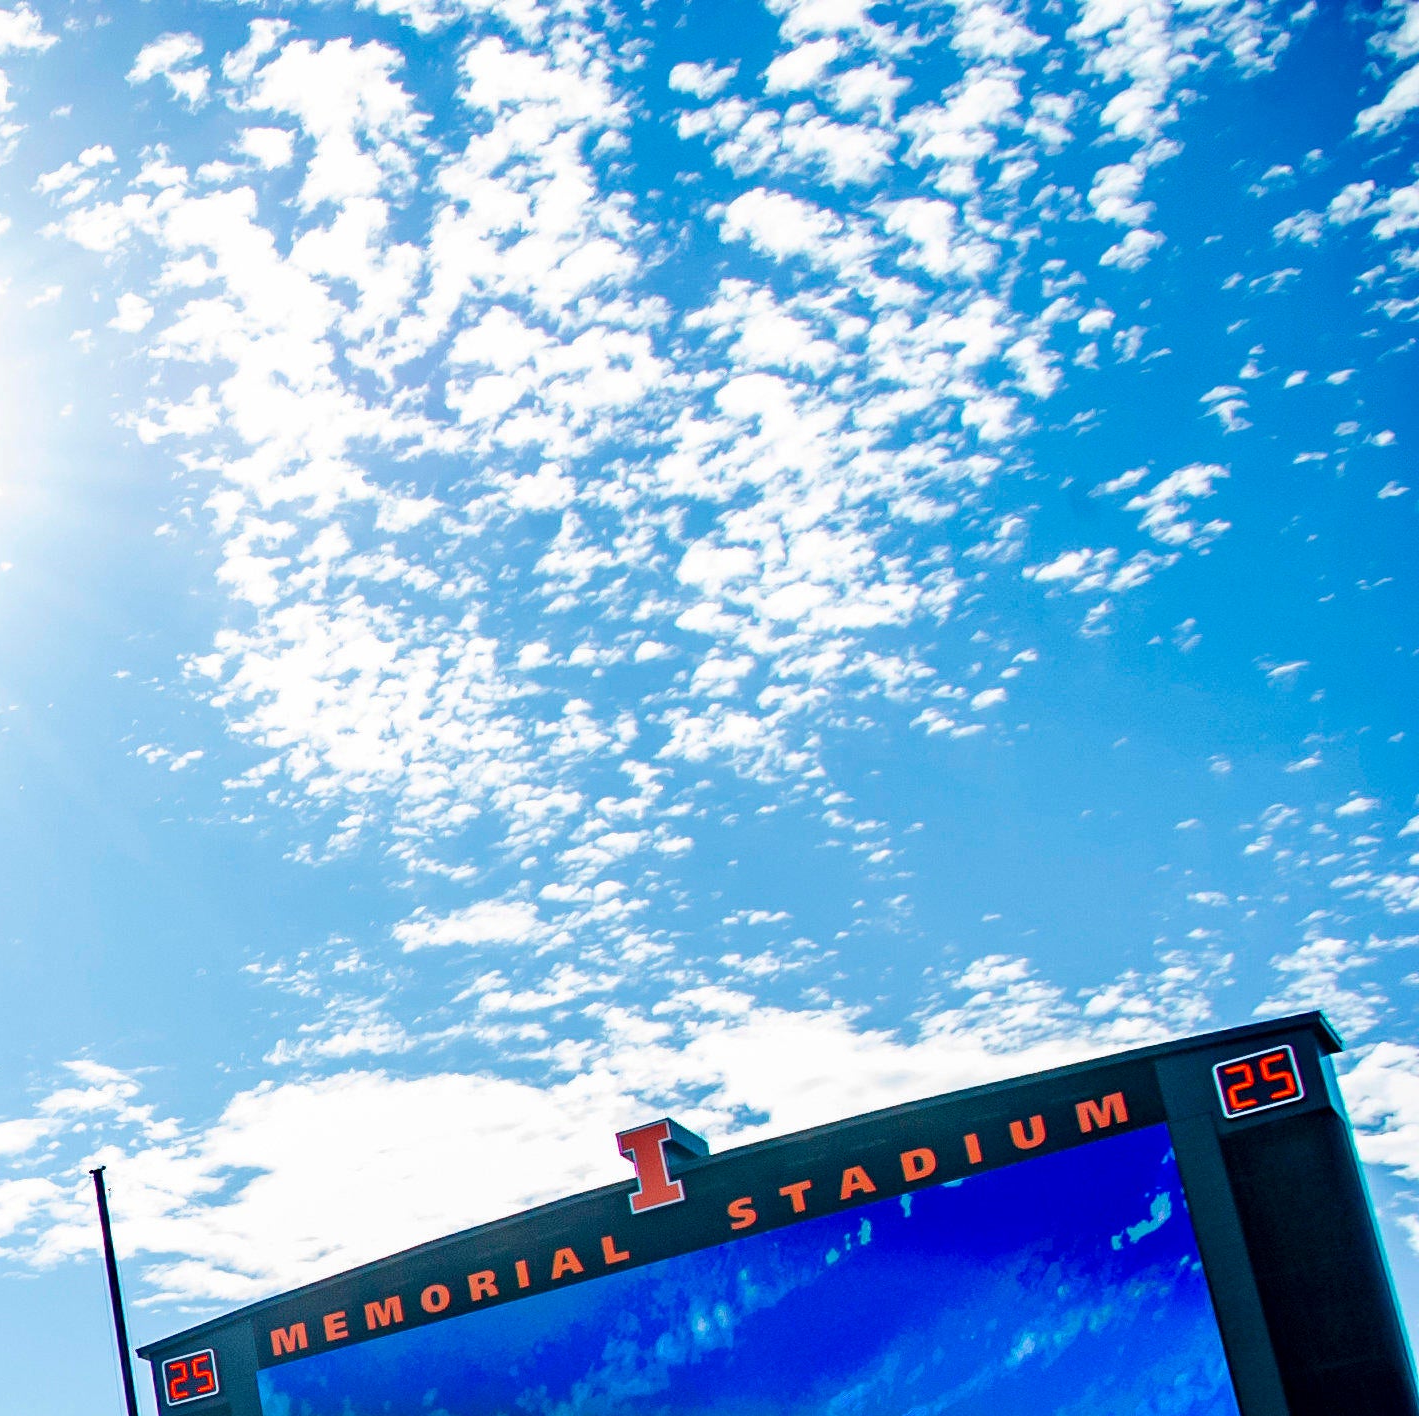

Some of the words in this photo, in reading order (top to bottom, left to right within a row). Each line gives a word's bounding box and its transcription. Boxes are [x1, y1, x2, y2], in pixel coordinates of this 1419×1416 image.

[1224, 1052, 1296, 1112] 25
[270, 1236, 631, 1356] MEMORIAL
[726, 1091, 1129, 1231] STADIUM
[168, 1354, 216, 1402] 25
